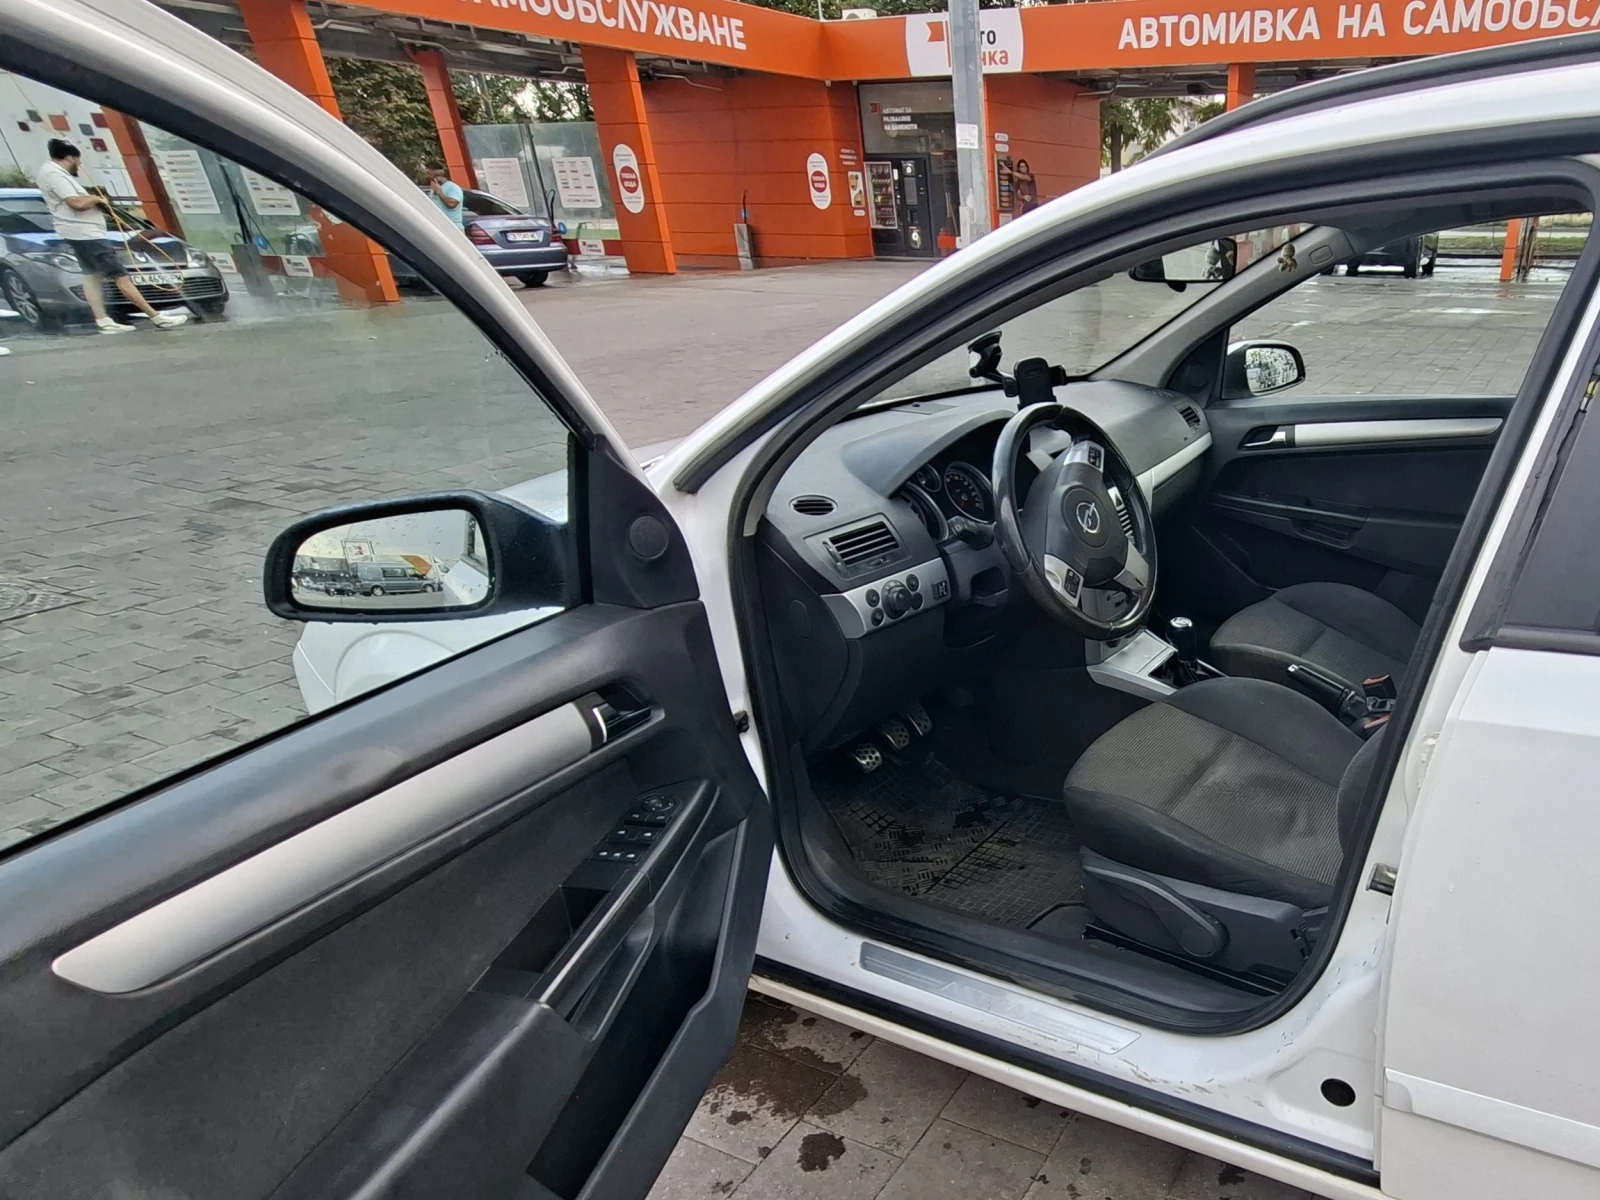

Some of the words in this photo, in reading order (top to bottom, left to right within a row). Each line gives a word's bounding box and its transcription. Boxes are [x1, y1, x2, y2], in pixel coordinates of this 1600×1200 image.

[462, 0, 747, 50] ООБСЛУЖВАНЕ
[1118, 6, 1321, 50] АВТОМИВКА
[1337, 2, 1386, 39] НА
